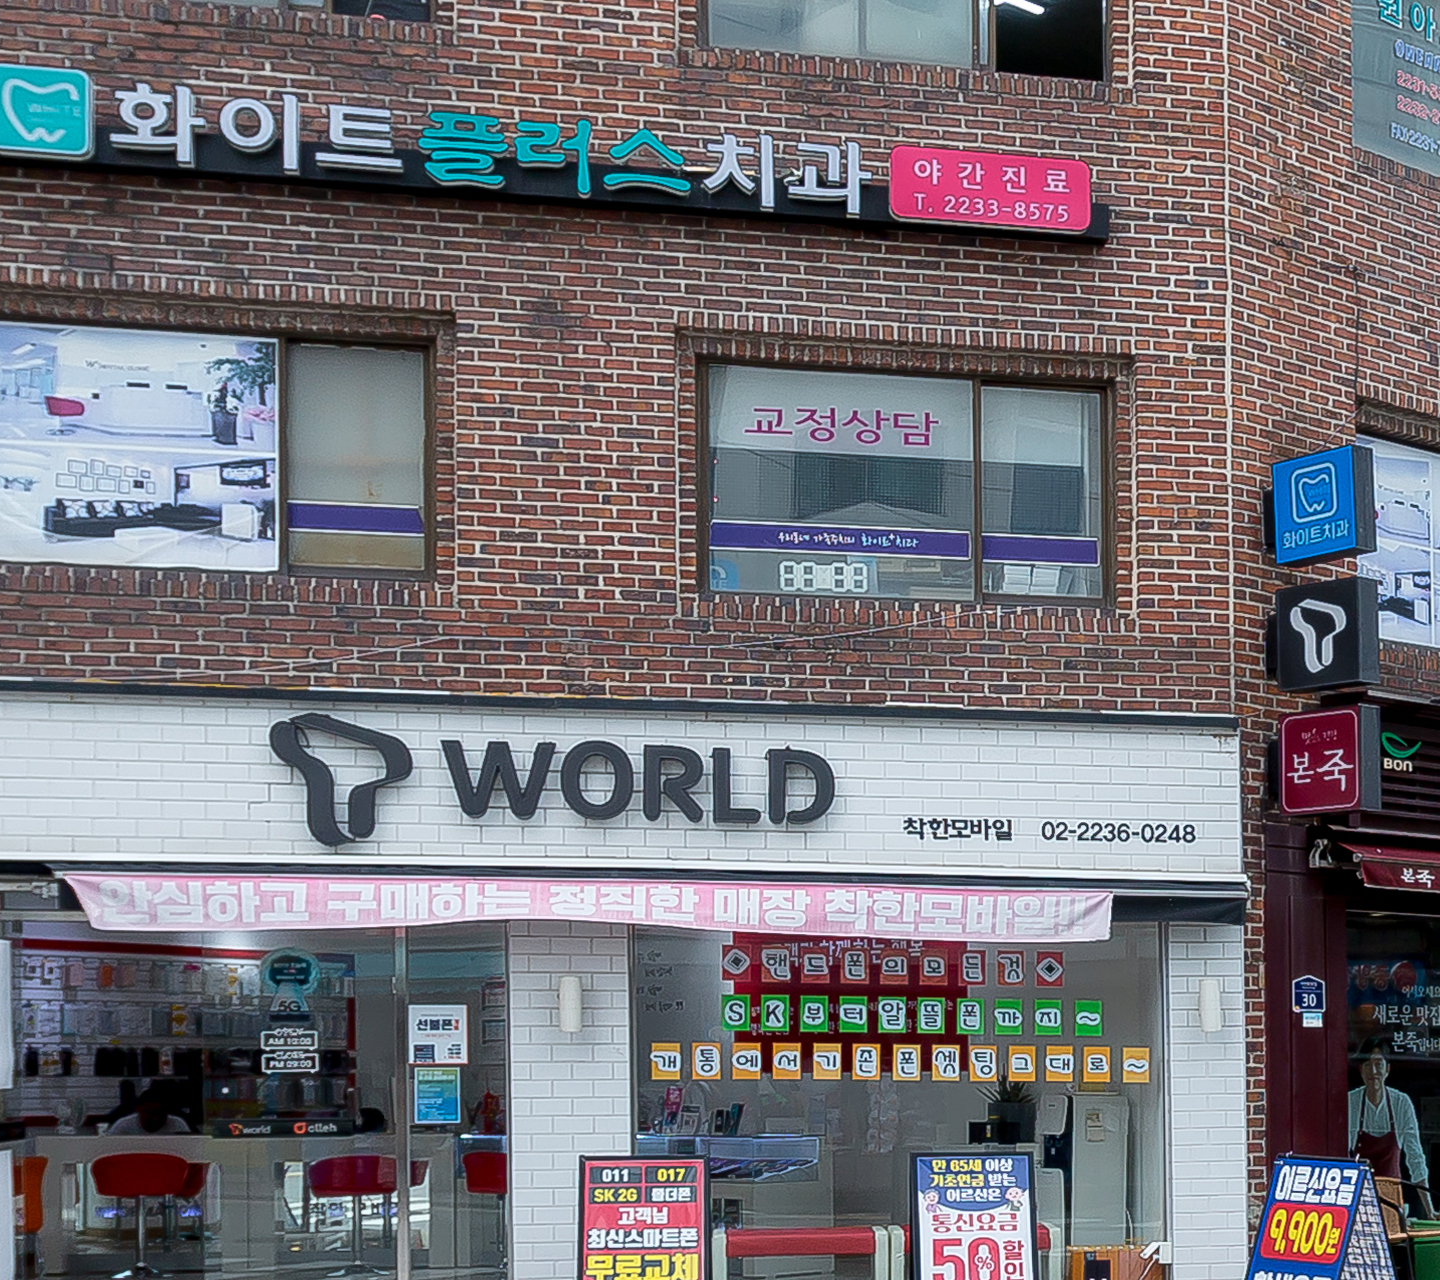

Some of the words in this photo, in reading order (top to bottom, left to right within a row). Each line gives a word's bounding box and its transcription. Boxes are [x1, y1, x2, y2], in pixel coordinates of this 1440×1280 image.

[110, 82, 872, 217] 화이트플러스치과
[914, 157, 1070, 194] 야간진료
[944, 196, 1070, 222] 2233-8575
[744, 407, 939, 446] 교정상담
[1282, 519, 1349, 549] 화이트치과
[1287, 749, 1354, 791] 본죽
[443, 738, 836, 826] WORLD
[903, 817, 1013, 842] 착한모바일
[1042, 821, 1196, 843] 02-2236-0248
[1400, 867, 1436, 888] 본죽
[98, 879, 308, 922] 안심하고
[328, 880, 534, 920] 구매하는
[548, 883, 699, 919] 정직한
[715, 887, 811, 929] 매장
[825, 890, 1084, 934] 착한모바일!!
[1302, 994, 1316, 1007] 30
[1373, 1004, 1413, 1026] 새로운
[602, 1168, 629, 1182] 011
[657, 1168, 685, 1182] 017
[932, 1159, 946, 1172] 만
[950, 1159, 982, 1172] 65세
[985, 1159, 1013, 1171] 이상
[930, 1174, 984, 1187] 기초연금
[988, 1174, 1016, 1187] 받는
[594, 1188, 615, 1202] SK
[617, 1188, 637, 1202] 2G
[652, 1187, 691, 1202] 폴더폰
[946, 1188, 1002, 1202] 어르신은
[618, 1207, 668, 1224] 고객님
[932, 1213, 1018, 1233] 통신요금
[587, 1228, 699, 1249] 최신스마트폰
